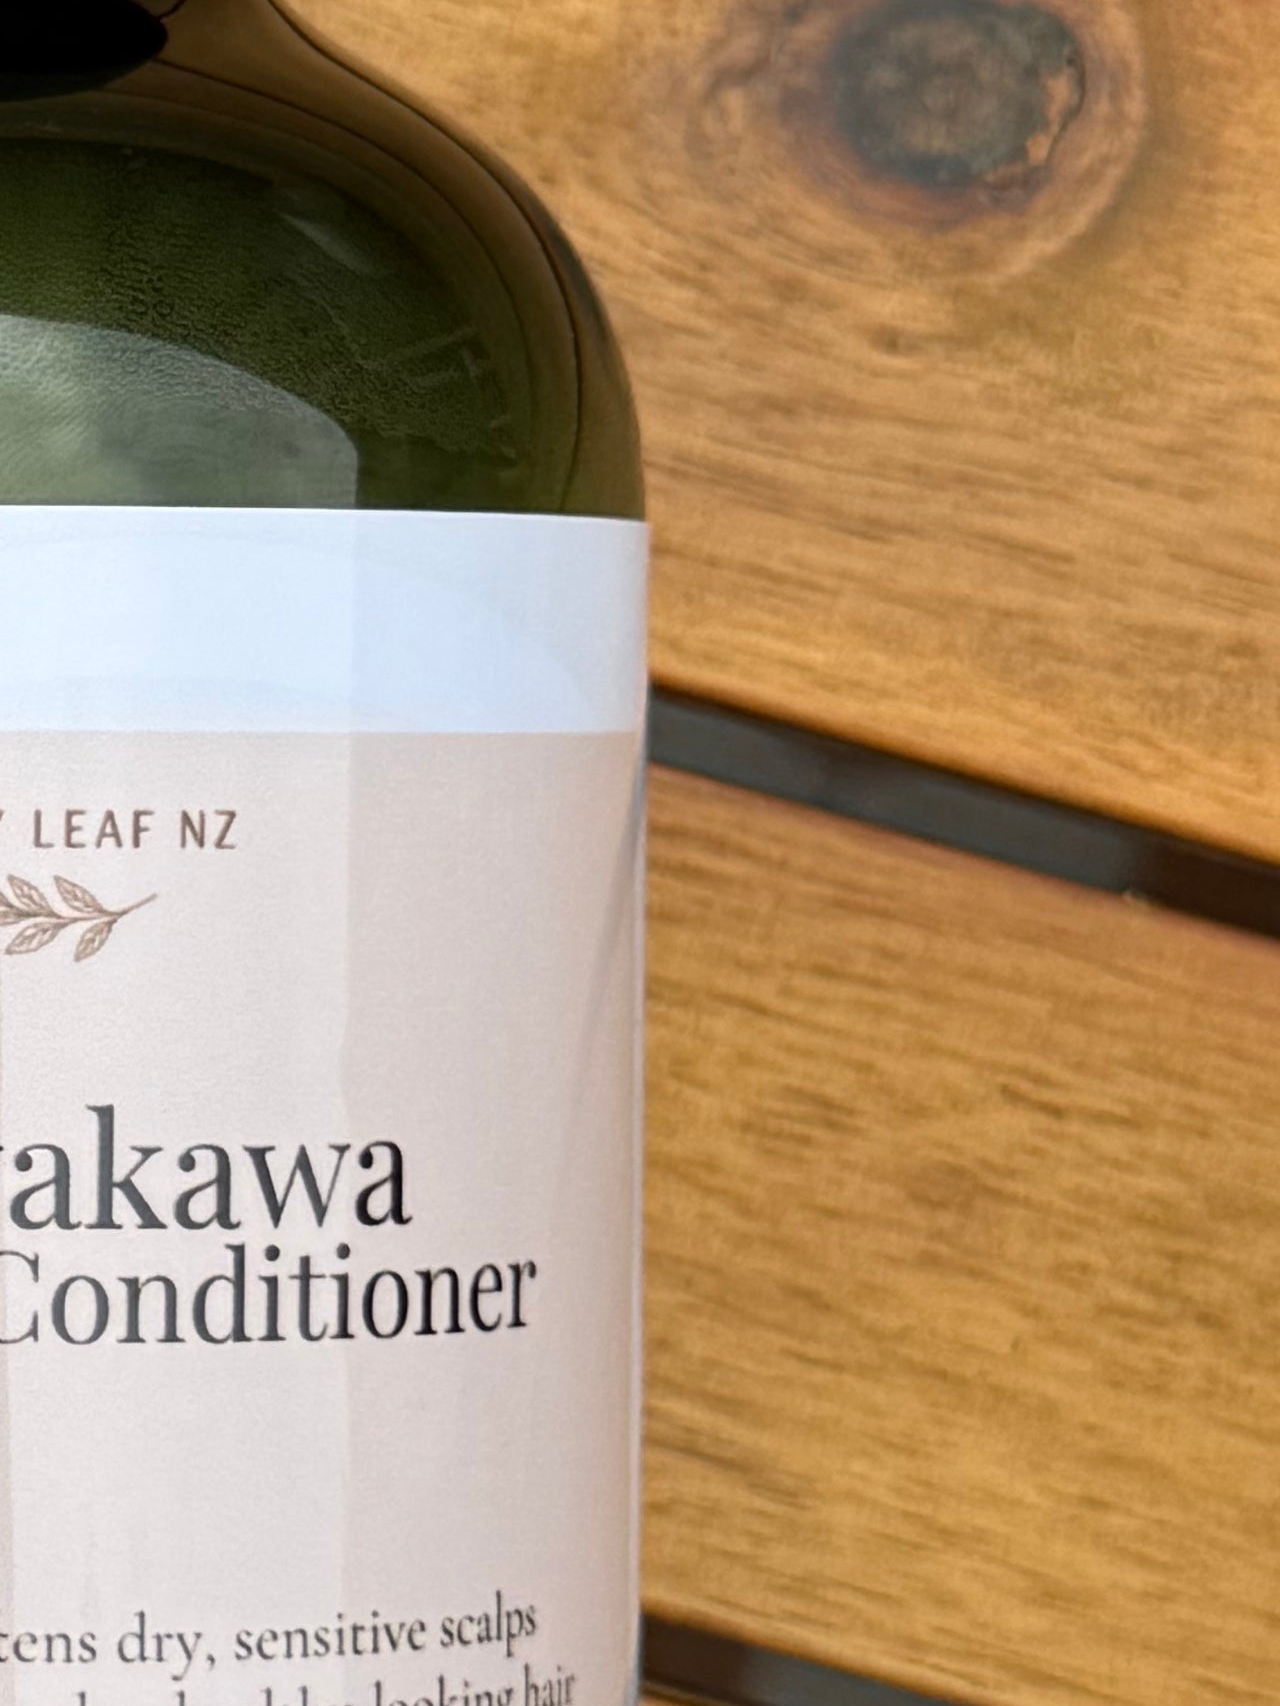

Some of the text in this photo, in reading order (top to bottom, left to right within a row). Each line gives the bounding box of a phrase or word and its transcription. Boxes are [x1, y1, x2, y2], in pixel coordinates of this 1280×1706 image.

[32, 808, 156, 850] LEAF
[179, 808, 238, 851] NZ
[116, 1609, 219, 1679] dry,
[233, 1609, 428, 1662] sensitive
[438, 1588, 538, 1656] scalps
